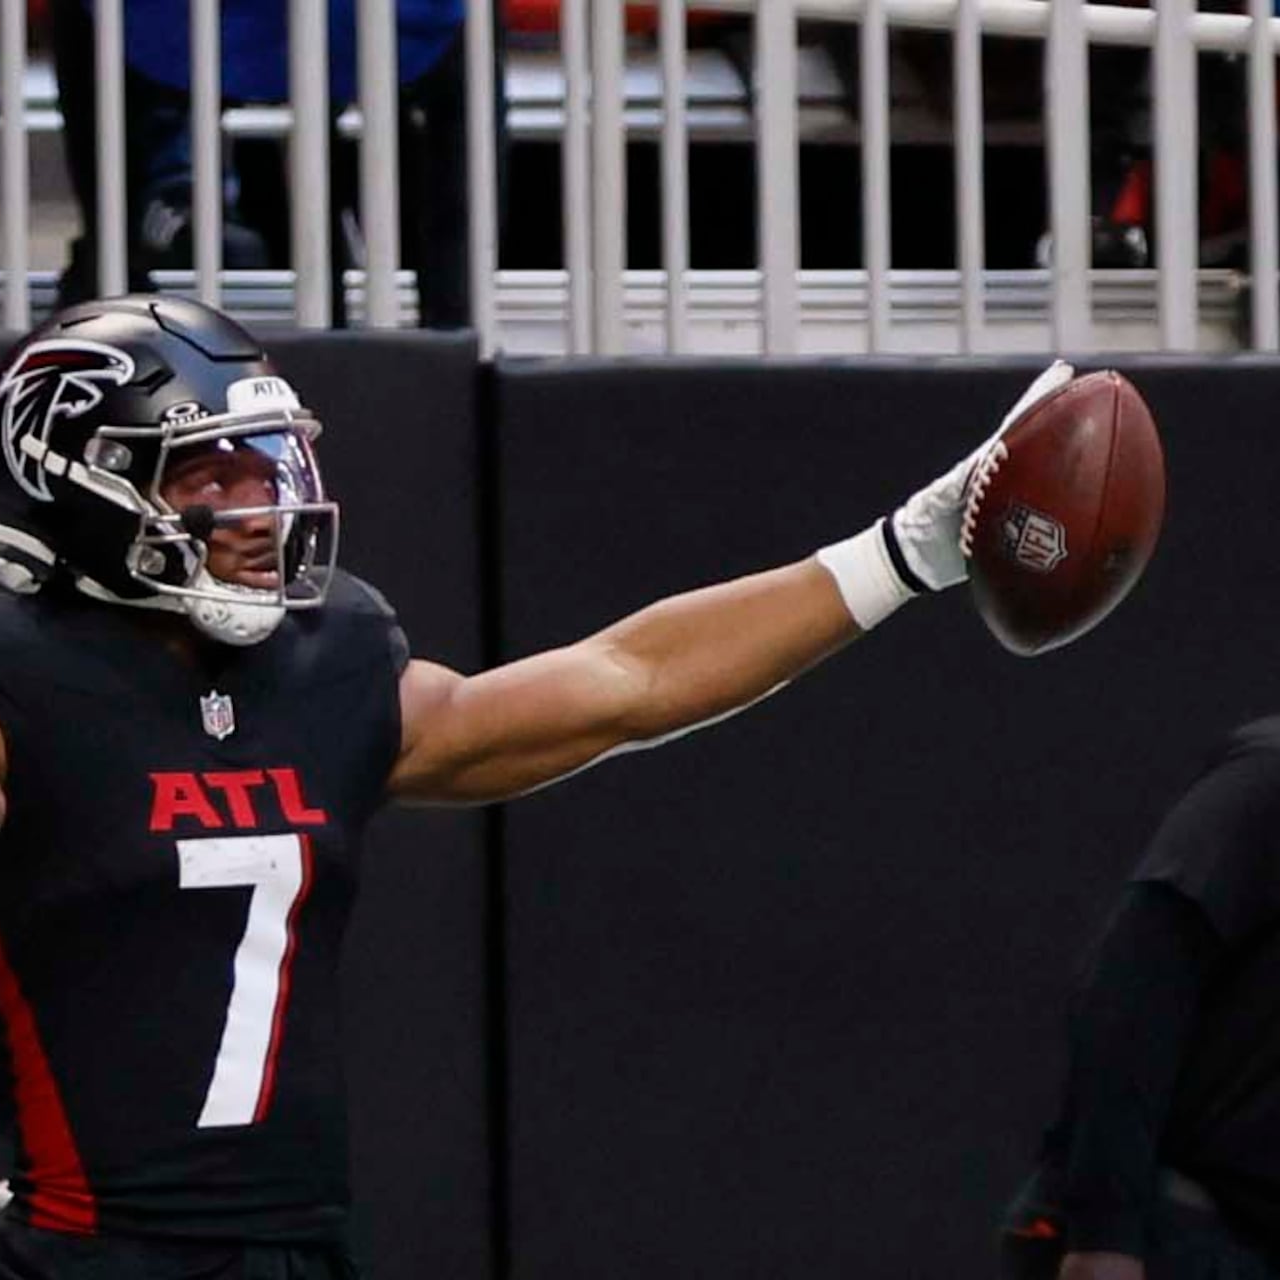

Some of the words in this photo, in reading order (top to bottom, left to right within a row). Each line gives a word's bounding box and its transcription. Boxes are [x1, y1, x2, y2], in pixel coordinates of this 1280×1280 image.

[1018, 521, 1057, 568] NFL
[149, 768, 328, 831] ATL
[176, 833, 315, 1128] 7
